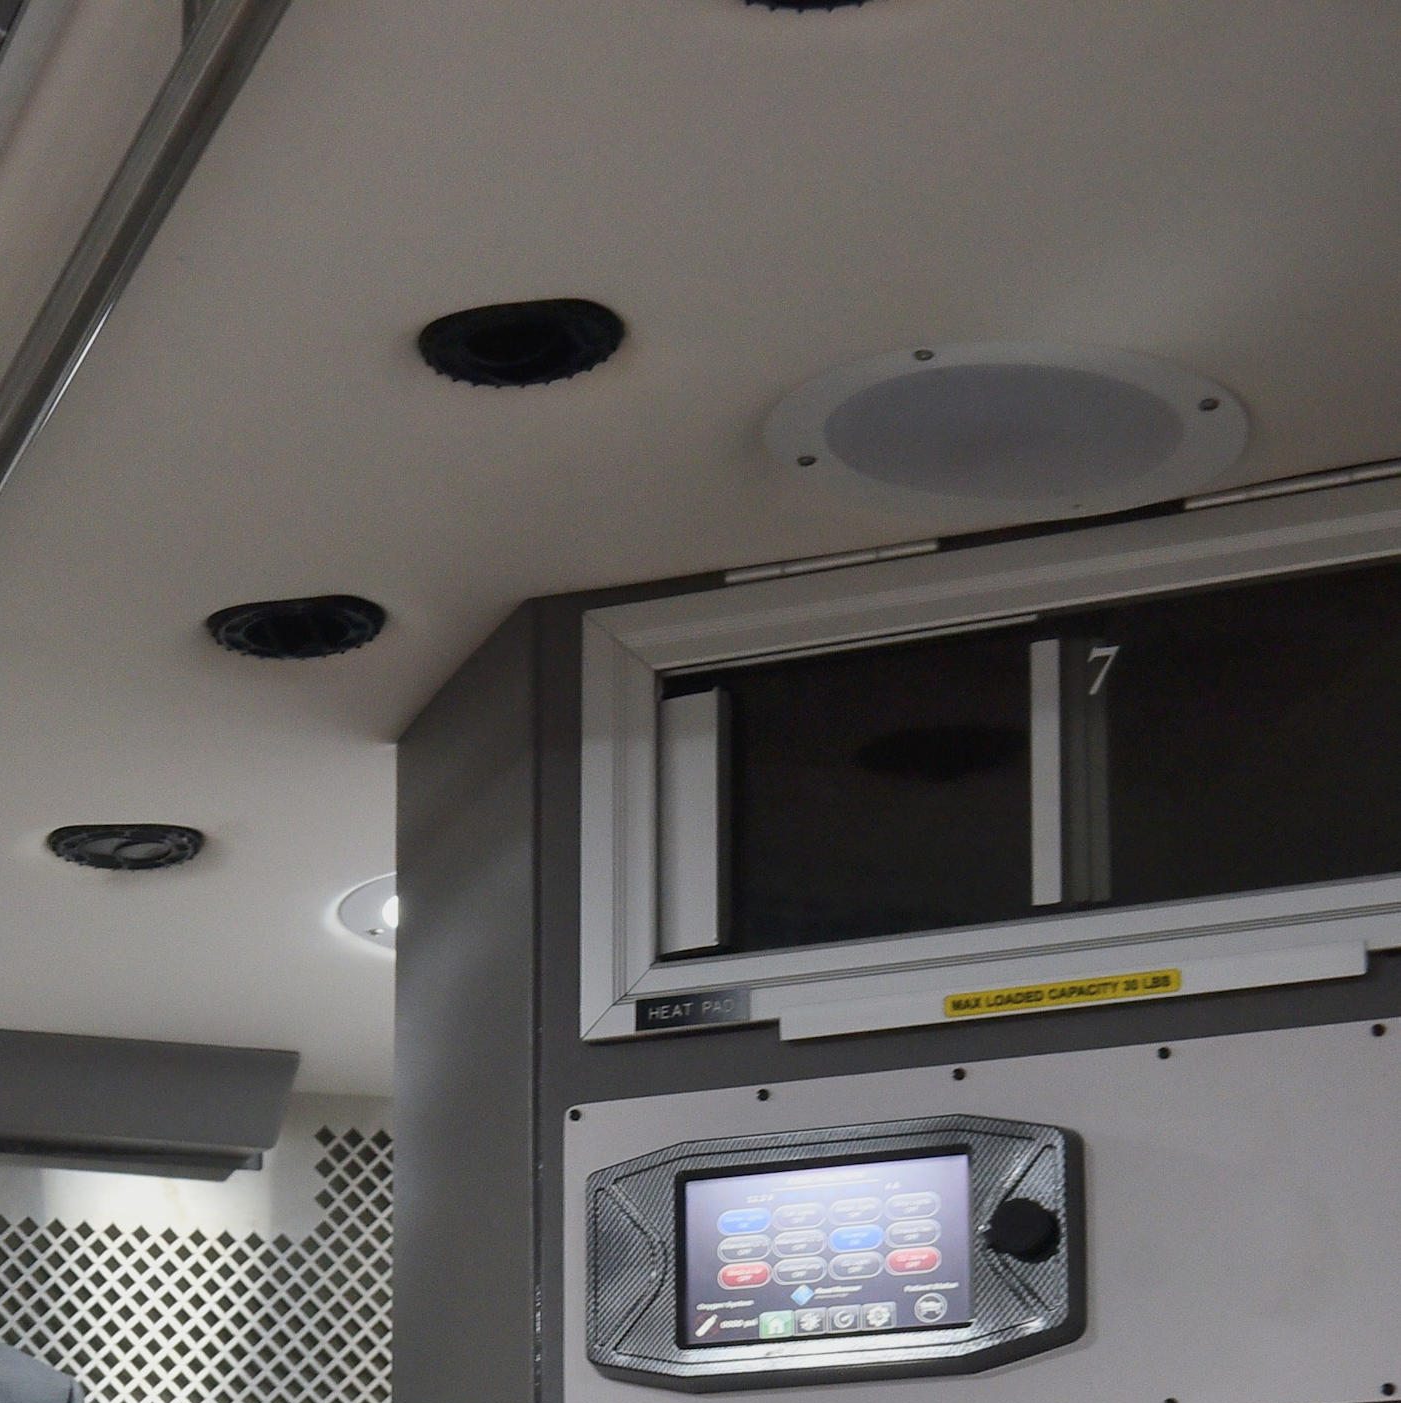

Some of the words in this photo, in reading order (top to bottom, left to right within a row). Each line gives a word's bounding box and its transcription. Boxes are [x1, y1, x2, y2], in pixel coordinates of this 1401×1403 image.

[1087, 645, 1120, 696] 7
[648, 1002, 695, 1020] HEAT
[701, 999, 736, 1015] PAD
[951, 998, 982, 1012] MAX
[985, 989, 1045, 1008] LOADED
[1047, 981, 1120, 1001] CAPACITY
[1142, 975, 1171, 990] LBS
